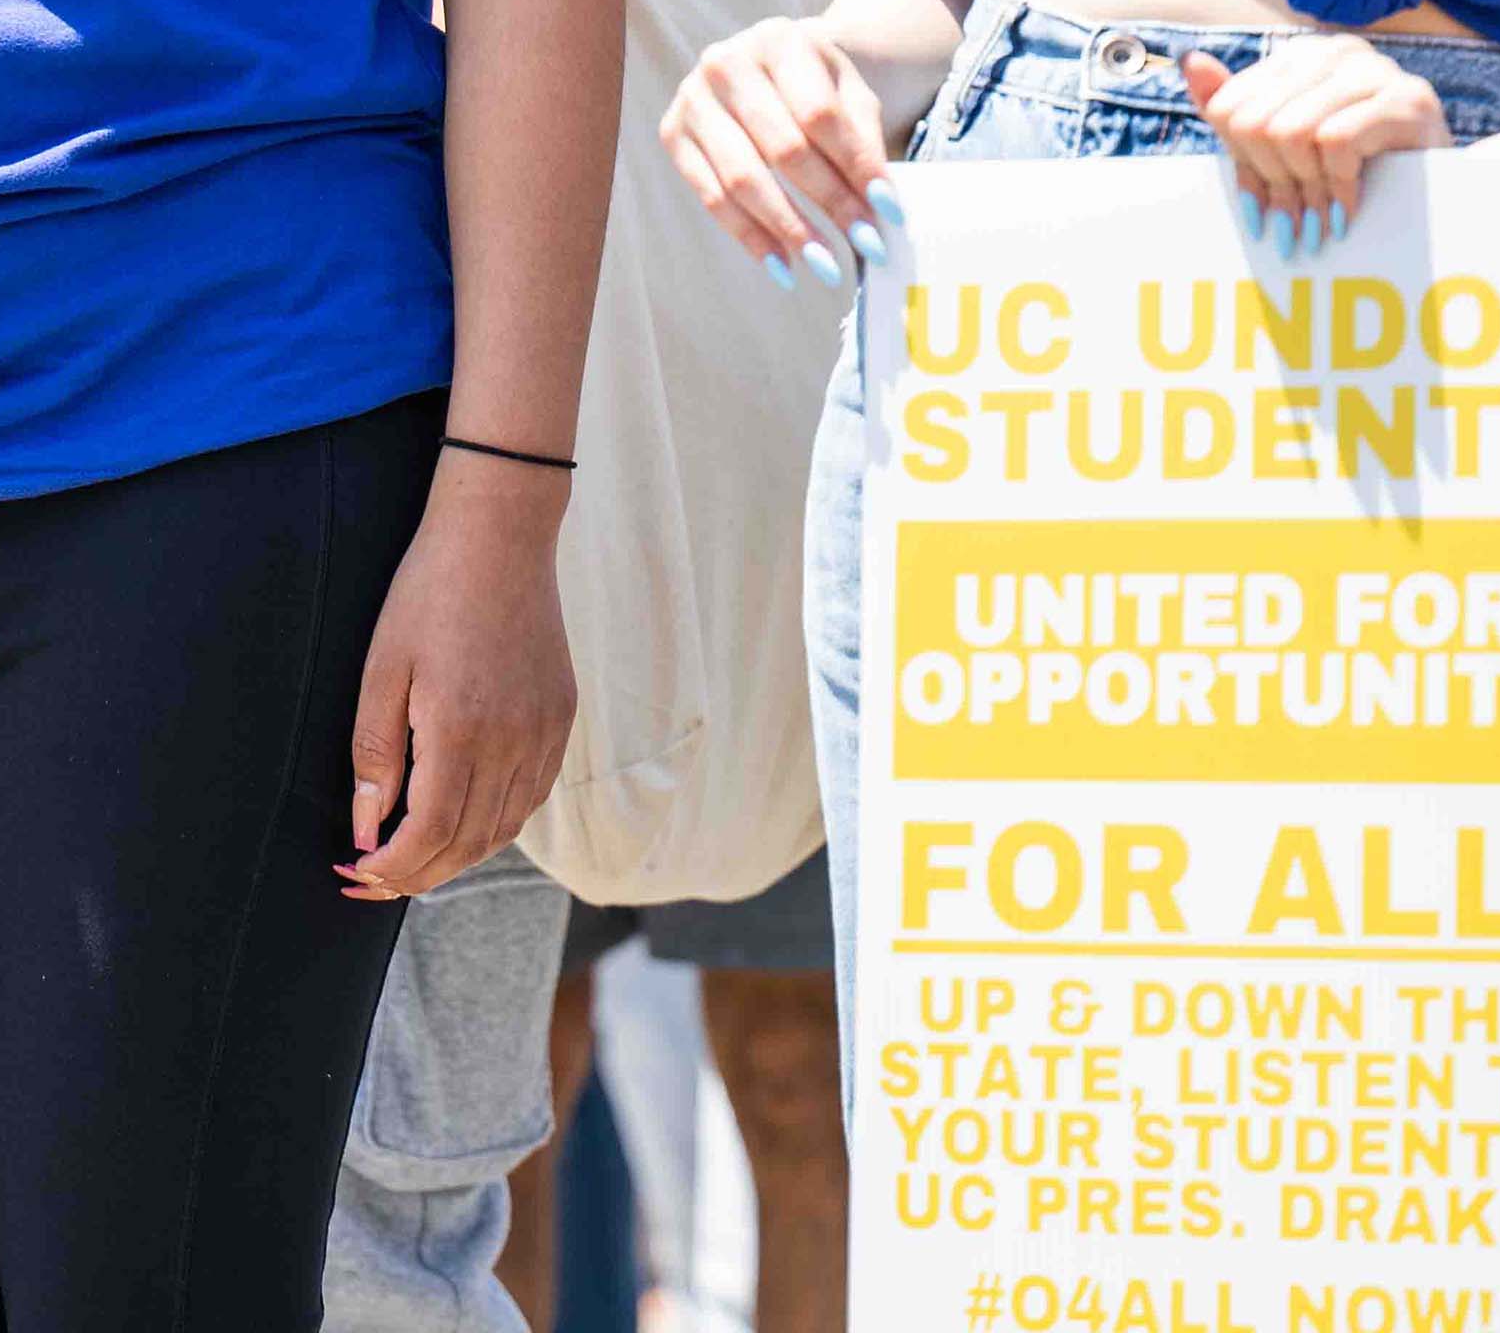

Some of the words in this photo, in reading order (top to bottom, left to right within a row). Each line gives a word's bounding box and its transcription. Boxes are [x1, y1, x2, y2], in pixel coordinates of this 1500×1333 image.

[904, 280, 1073, 378] UC
[953, 572, 1304, 649] UNITED
[901, 821, 1191, 935] FOR
[919, 978, 1016, 1035] UP
[1048, 980, 1102, 1037] &
[1133, 982, 1365, 1040] DOWN
[878, 1042, 1146, 1115] STATE,
[1176, 1047, 1455, 1110] LISTEN
[890, 1107, 1102, 1167] YOUR
[895, 1174, 996, 1232] UC
[1028, 1176, 1246, 1238] PRES.
[1288, 1284, 1494, 1333] NOW!
